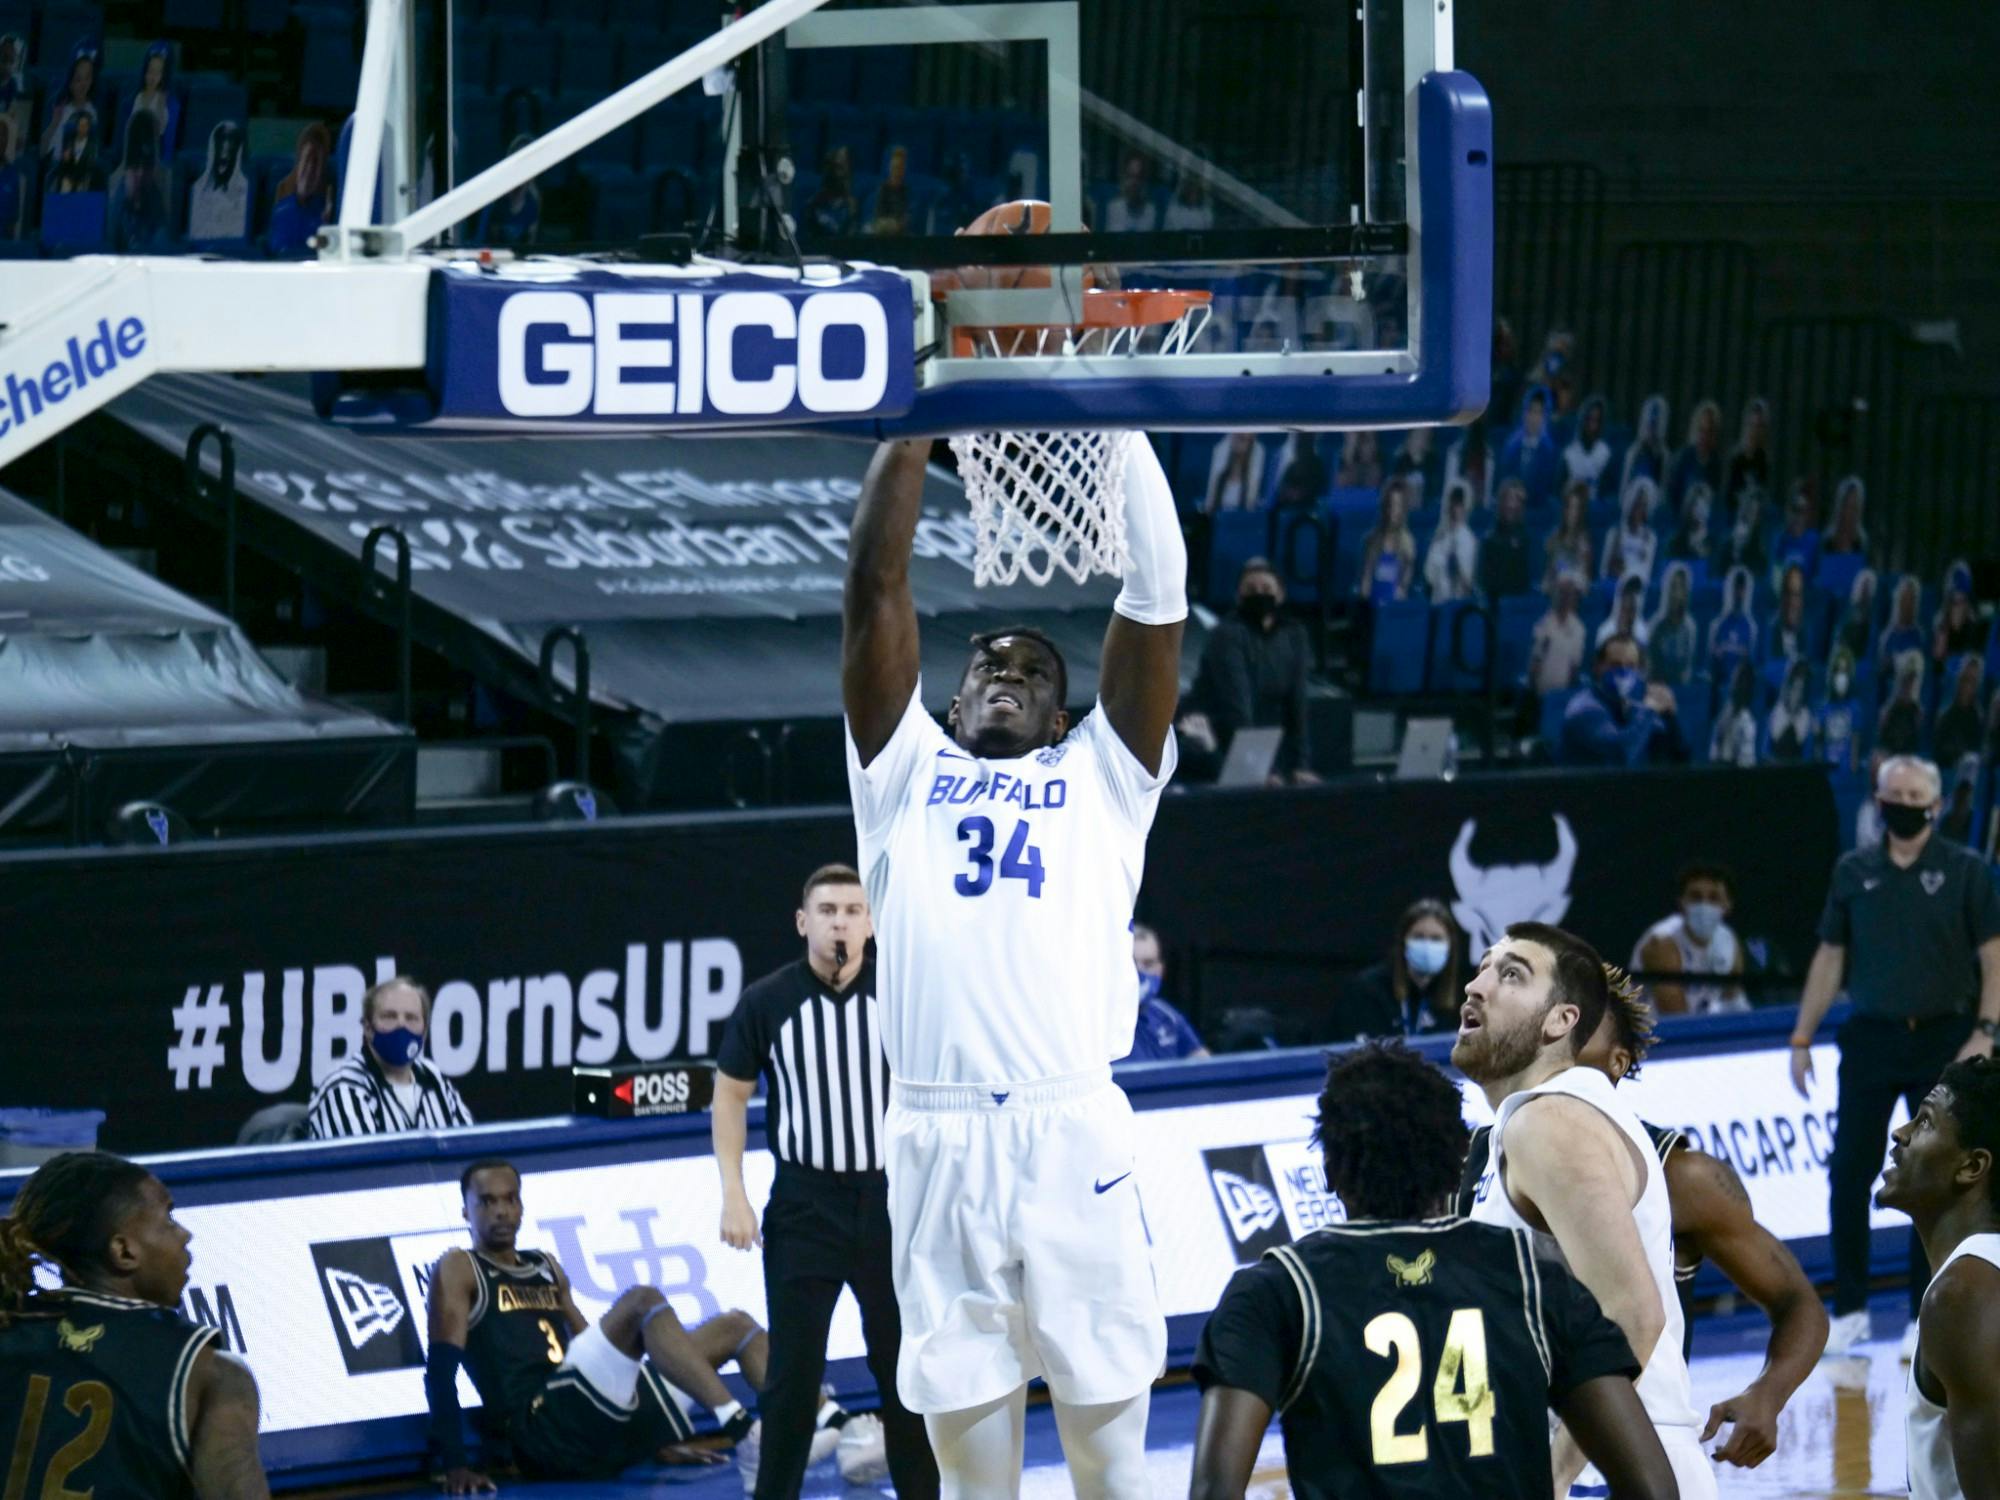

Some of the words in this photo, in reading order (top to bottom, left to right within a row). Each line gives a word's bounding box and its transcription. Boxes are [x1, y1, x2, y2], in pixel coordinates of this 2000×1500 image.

[498, 291, 888, 417] GEICO
[502, 513, 799, 569] Suburban
[926, 771, 1067, 811] BUFFALO
[954, 815, 1046, 899] 34
[167, 937, 743, 1094] #UBornsUP
[633, 1071, 690, 1105] POSS
[538, 1319, 564, 1364] 3
[1363, 1307, 1496, 1465] 24
[2, 1373, 115, 1500] 12
